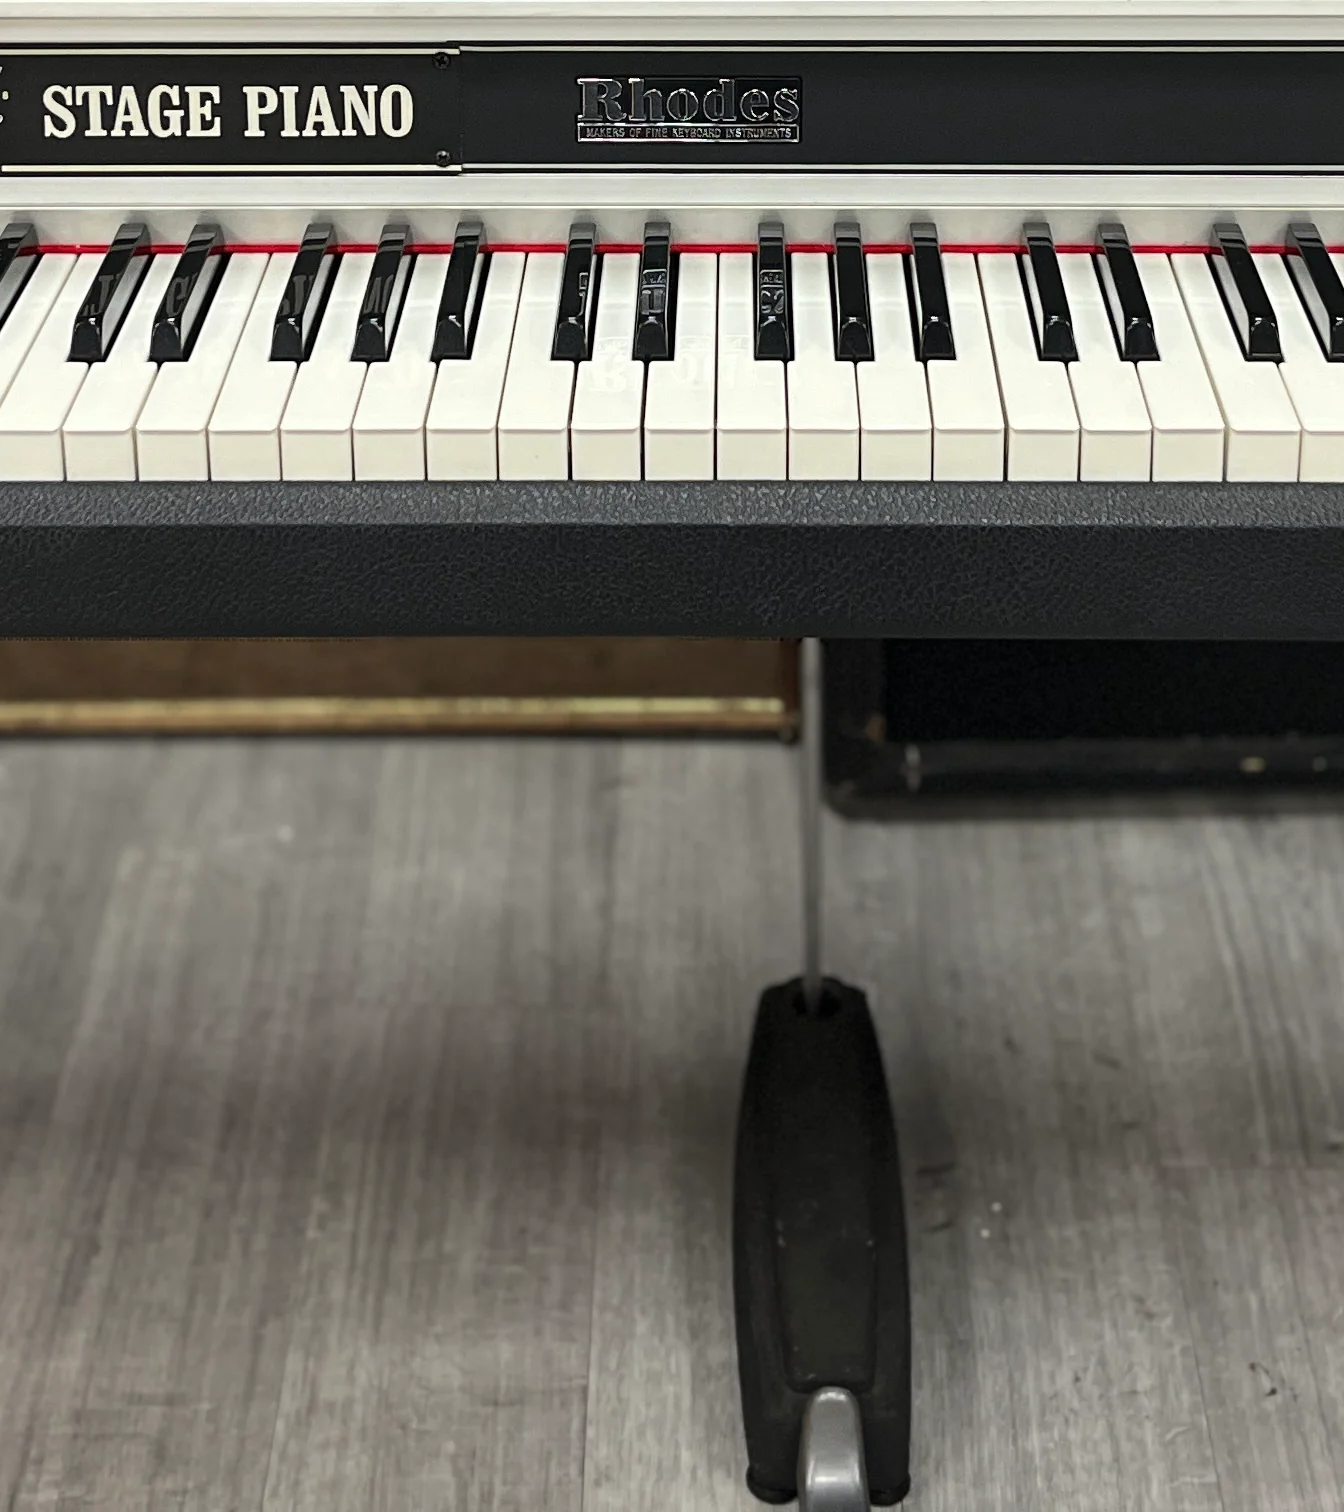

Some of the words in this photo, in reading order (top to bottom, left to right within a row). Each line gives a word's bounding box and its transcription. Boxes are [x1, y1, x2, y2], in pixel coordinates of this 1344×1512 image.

[1, 91, 9, 100] 8
[577, 78, 800, 122] Rhodes
[42, 84, 222, 139] STAGE
[242, 84, 415, 139] PIANO
[586, 126, 626, 139] MAKERS
[629, 127, 641, 138] OF
[645, 127, 668, 138] FINE
[672, 126, 721, 138] KEYBOARD
[725, 126, 792, 138] INSTRUMENTS
